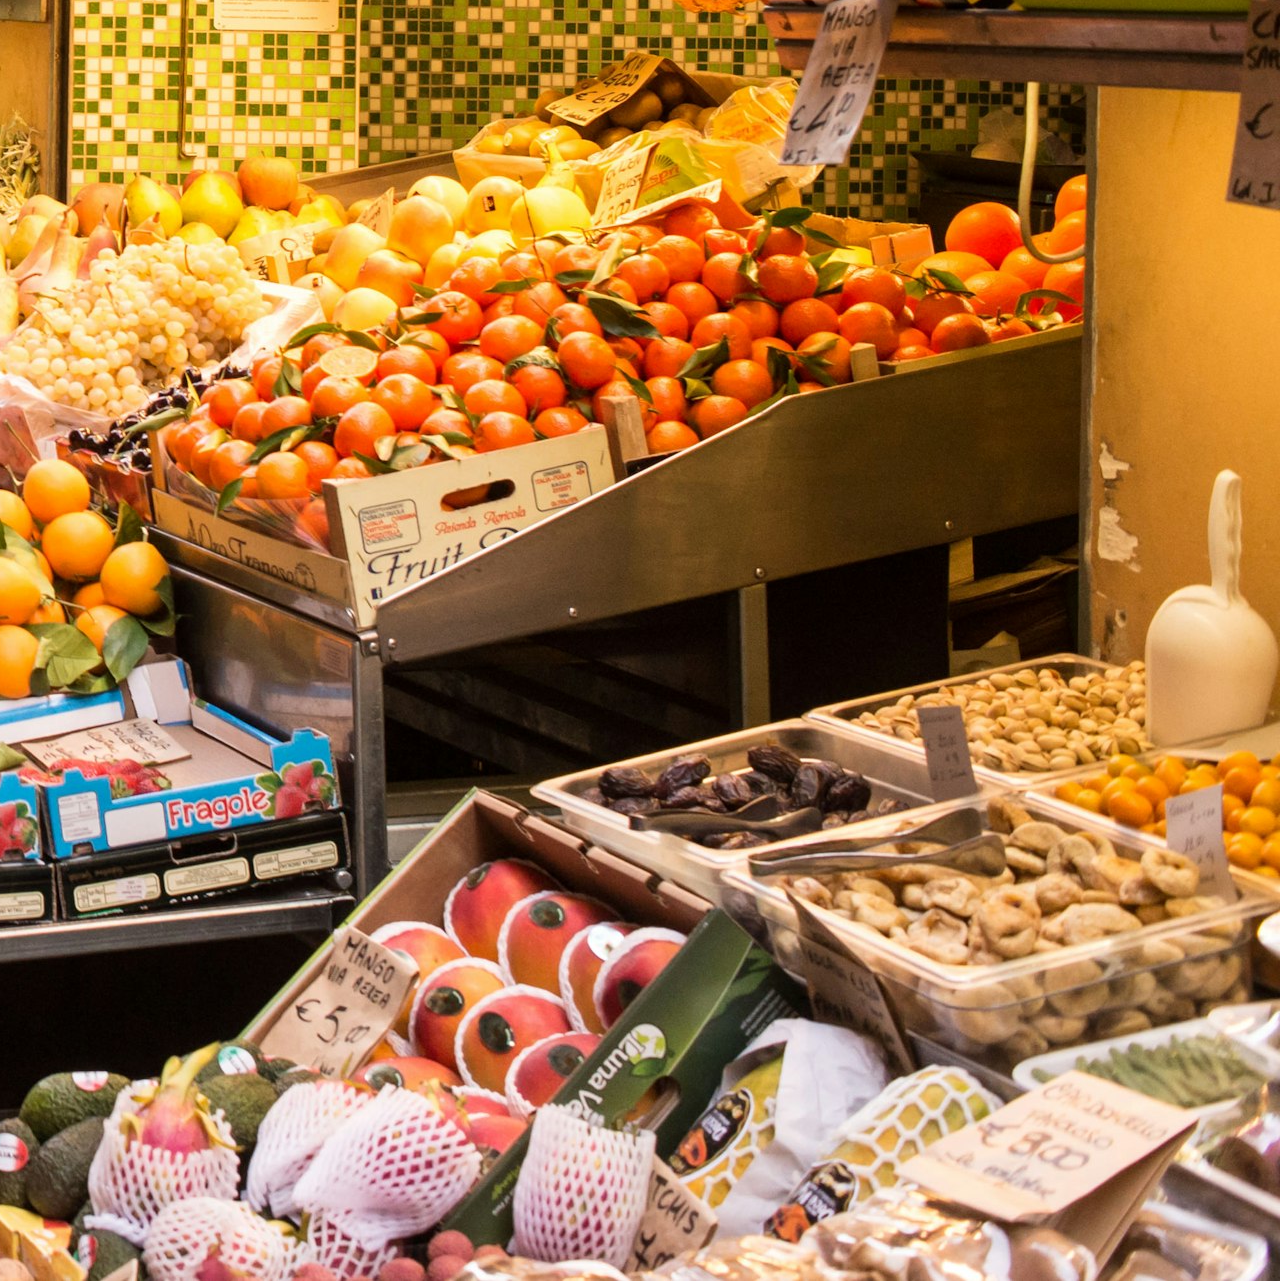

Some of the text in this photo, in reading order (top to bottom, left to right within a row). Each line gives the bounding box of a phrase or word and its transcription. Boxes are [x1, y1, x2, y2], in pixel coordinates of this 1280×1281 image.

[823, 5, 877, 32] MANGO
[367, 541, 465, 586] Fruit
[166, 788, 270, 827] Fragole
[327, 964, 348, 986] VIA
[343, 936, 396, 985] MANGO
[295, 998, 321, 1023] €
